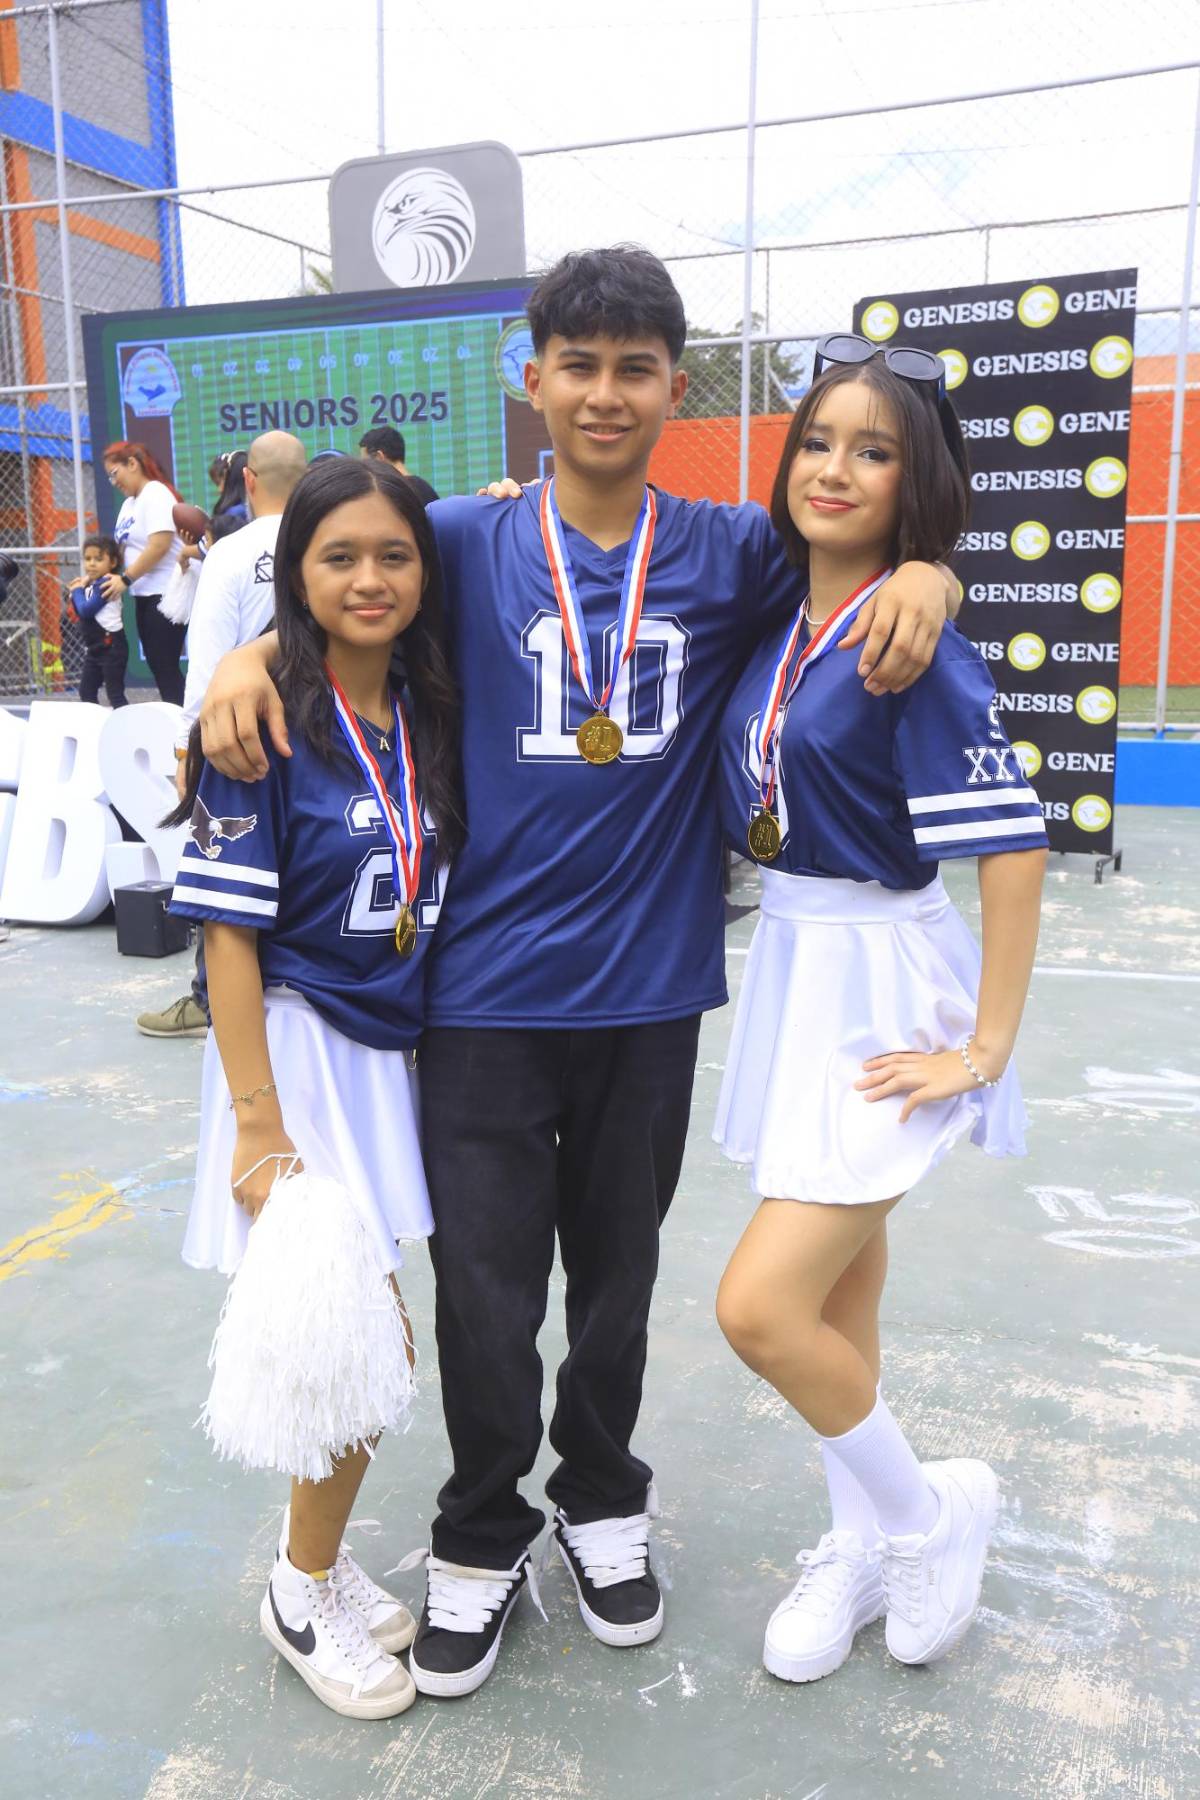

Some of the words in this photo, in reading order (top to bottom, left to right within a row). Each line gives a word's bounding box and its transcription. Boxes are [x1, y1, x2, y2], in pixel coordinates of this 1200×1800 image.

[904, 299, 1014, 328] GENESIS
[1064, 286, 1136, 313] GENE
[972, 349, 1088, 377] GENESIS
[219, 396, 359, 433] SENIORS
[370, 391, 449, 425] 2025
[1059, 410, 1130, 434] GENE
[970, 468, 1082, 491] GENESIS
[1055, 529, 1124, 550] GENE
[968, 583, 1078, 602] GENESIS
[1051, 642, 1119, 662] GENE
[516, 609, 692, 763] 10
[994, 693, 1073, 713] NESIS
[1047, 752, 1114, 773] GENE
